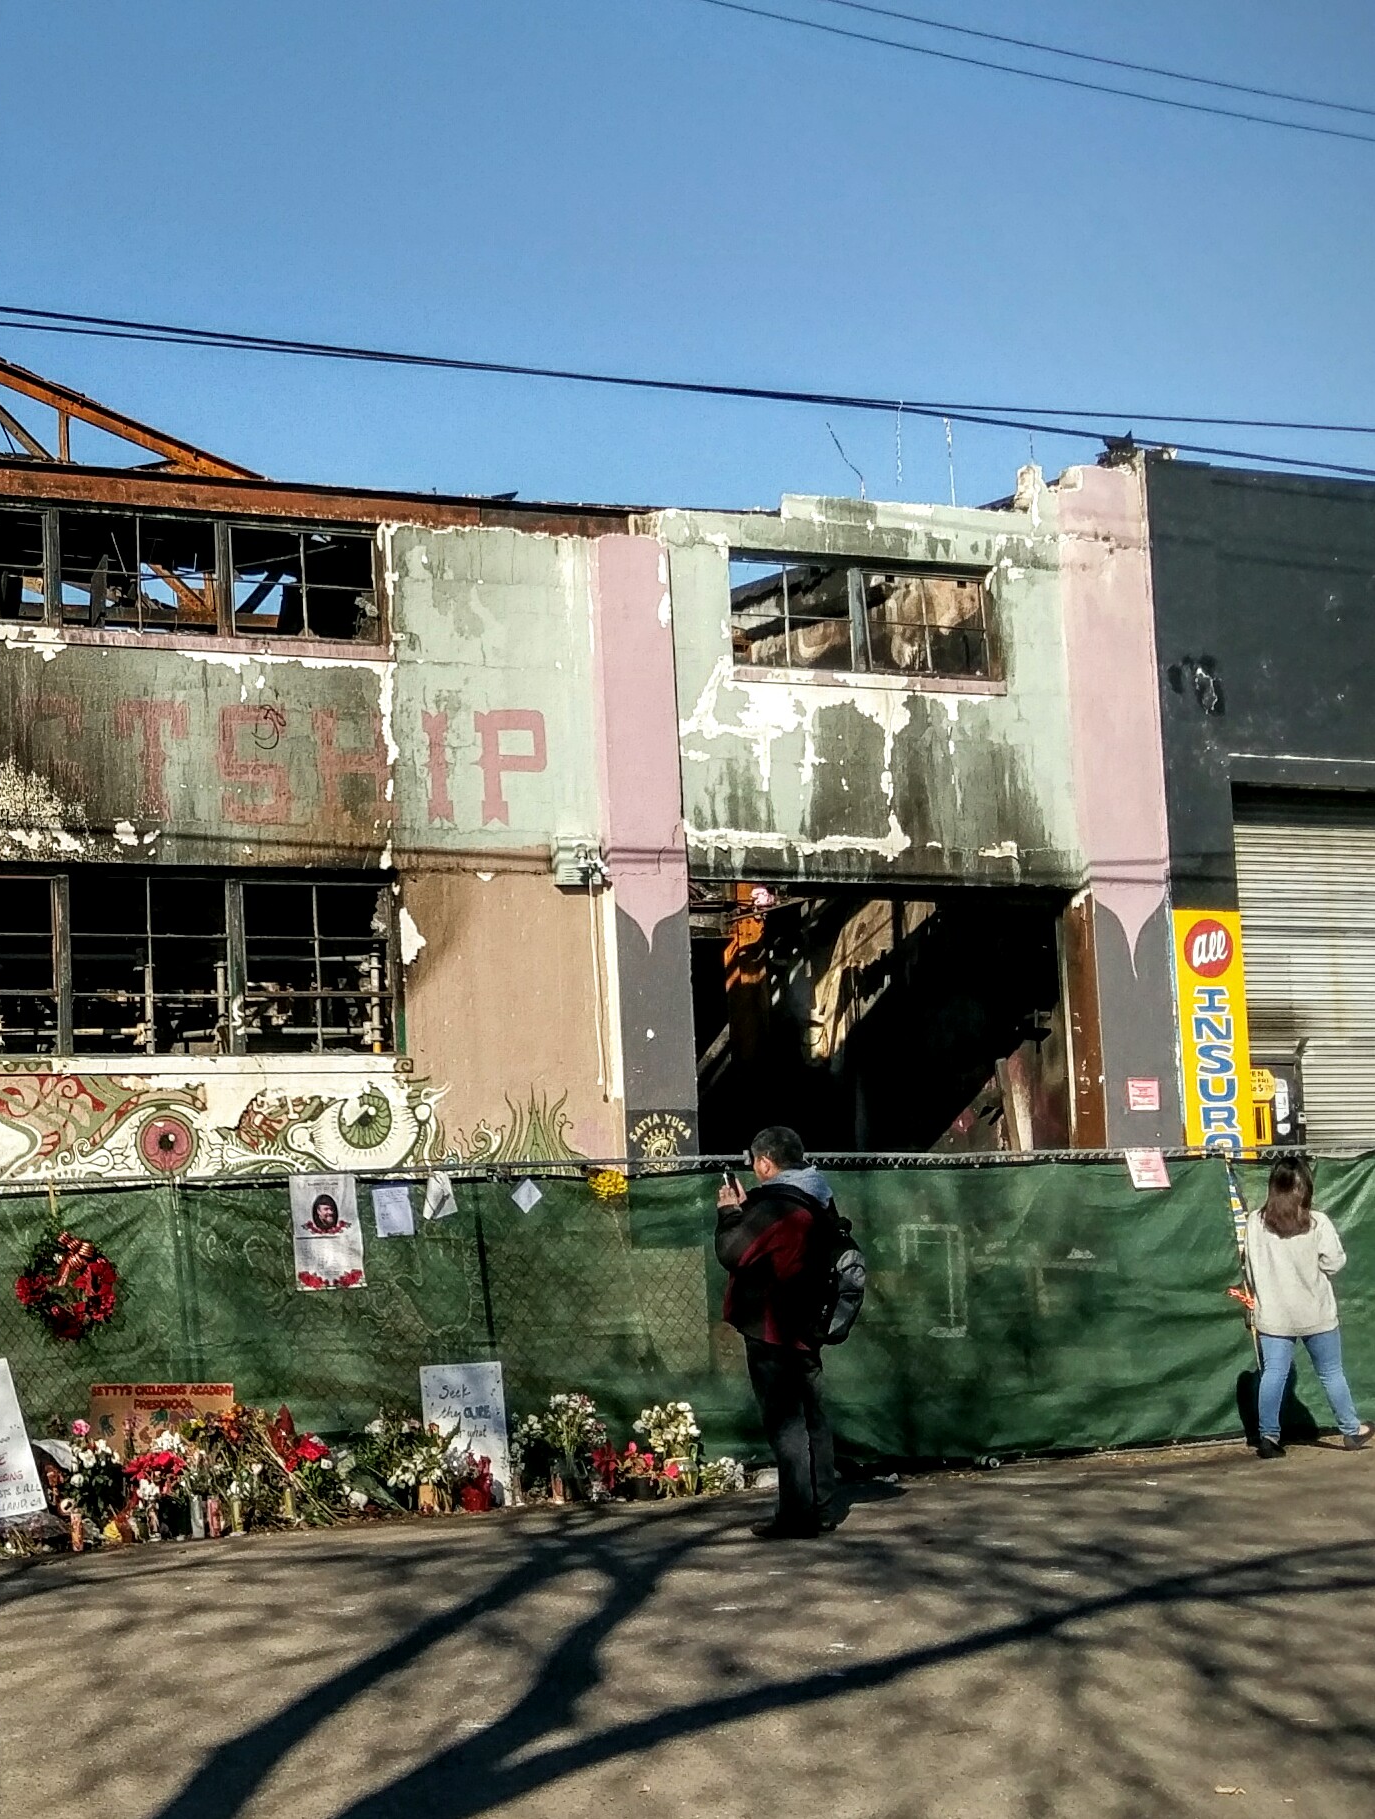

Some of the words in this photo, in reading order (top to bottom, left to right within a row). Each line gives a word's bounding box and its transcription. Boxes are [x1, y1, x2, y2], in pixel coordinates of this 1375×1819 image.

[629, 1113, 661, 1143] SATYA
[664, 1113, 692, 1139] YUGA
[439, 1384, 471, 1399] Seek
